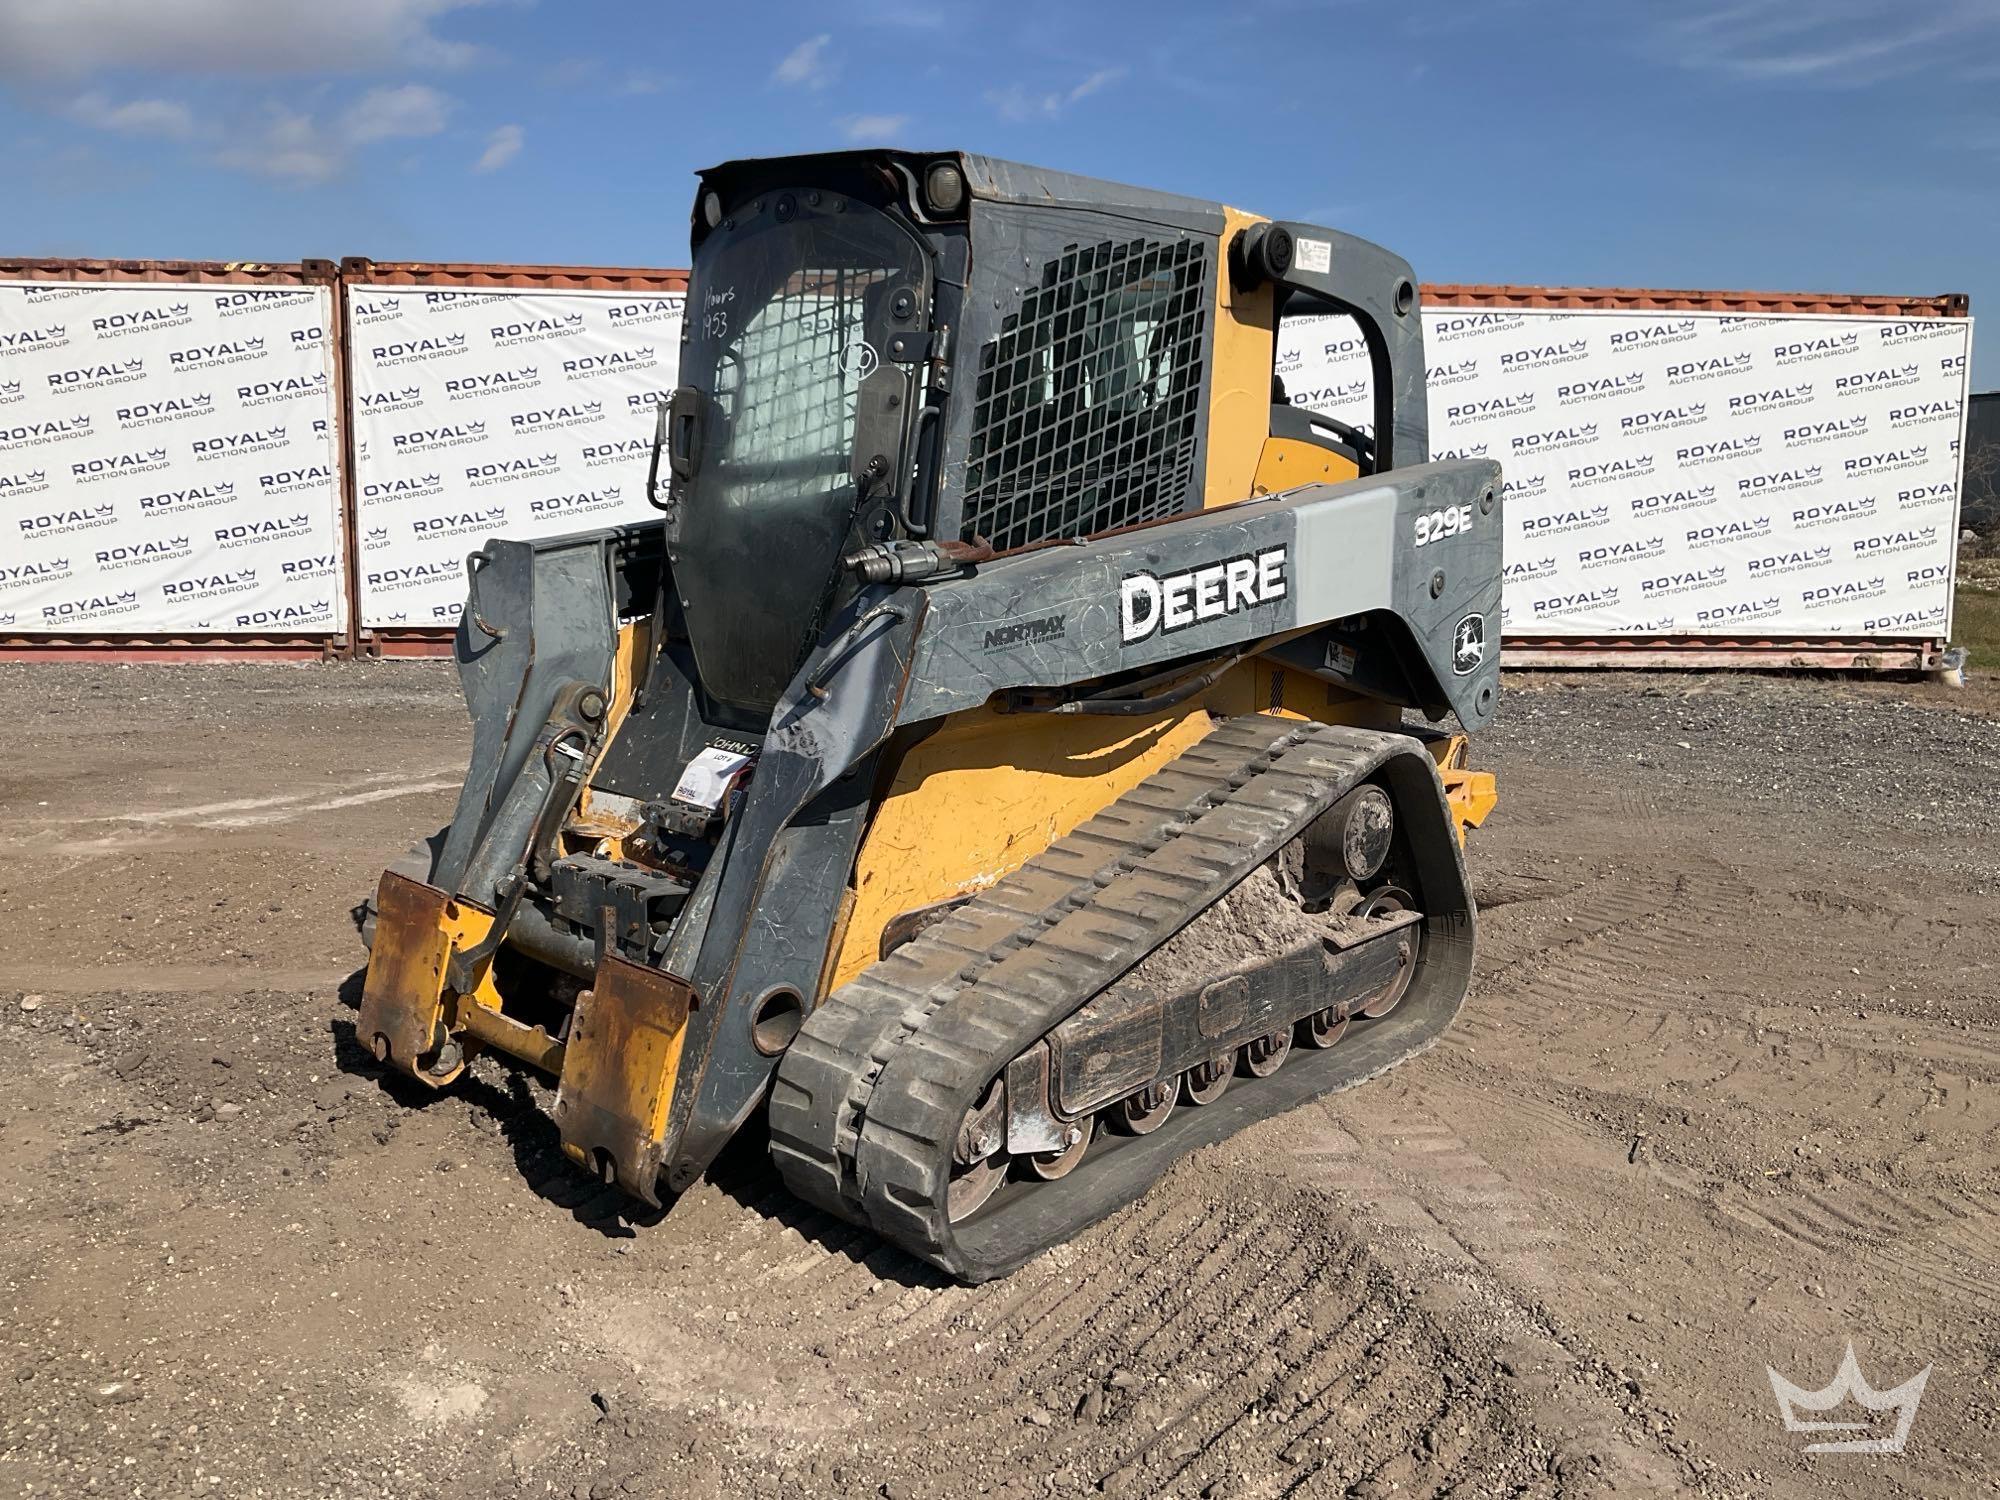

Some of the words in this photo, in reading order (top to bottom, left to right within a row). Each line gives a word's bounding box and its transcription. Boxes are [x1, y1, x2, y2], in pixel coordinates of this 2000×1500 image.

[93, 308, 170, 331] ROYAL
[97, 325, 149, 340] AUCTION
[151, 317, 192, 330] GROUP
[490, 318, 565, 339] ROYAL
[1436, 313, 1504, 334] ROYAL
[495, 334, 545, 347] AUCTION
[546, 327, 586, 339] GROUP
[1438, 328, 1485, 342] AUCTION
[1487, 321, 1524, 333] GROUP
[1610, 324, 1678, 345] ROYAL
[169, 342, 246, 364] ROYAL
[372, 338, 447, 359] ROYAL
[1612, 340, 1659, 353] AUCTION
[1661, 332, 1698, 344] GROUP
[1774, 338, 1841, 358] ROYAL
[173, 359, 225, 373] AUCTION
[227, 351, 267, 364] GROUP
[376, 354, 427, 368] AUCTION
[429, 347, 469, 359] GROUP
[563, 351, 636, 372] ROYAL
[1500, 344, 1569, 365] ROYAL
[1503, 360, 1551, 373] AUCTION
[1552, 352, 1589, 364] GROUP
[1777, 353, 1823, 366] AUCTION
[1824, 346, 1860, 357] GROUP
[47, 364, 125, 386] ROYAL
[567, 368, 617, 381] AUCTION
[618, 360, 657, 372] GROUP
[1666, 357, 1734, 377] ROYAL
[1669, 372, 1716, 385] AUCTION
[1717, 365, 1753, 377] GROUP
[53, 381, 105, 395] AUCTION
[106, 372, 148, 385] GROUP
[238, 377, 312, 399] ROYAL
[445, 371, 519, 393] ROYAL
[1557, 377, 1626, 398] ROYAL
[1835, 369, 1902, 389] ROYAL
[1838, 384, 1883, 397] AUCTION
[1885, 377, 1921, 388] GROUP
[242, 393, 292, 408] AUCTION
[449, 388, 499, 401] AUCTION
[501, 380, 540, 392] GROUP
[1560, 392, 1607, 406] AUCTION
[1609, 385, 1646, 397] GROUP
[1729, 388, 1796, 408] ROYAL
[116, 398, 193, 421] ROYAL
[510, 405, 584, 427] ROYAL
[1447, 397, 1517, 418] ROYAL
[1450, 413, 1498, 426] AUCTION
[1499, 405, 1536, 417] GROUP
[1731, 403, 1777, 416] AUCTION
[1779, 396, 1815, 408] GROUP
[121, 415, 173, 429] AUCTION
[175, 407, 216, 420] GROUP
[515, 422, 565, 435] AUCTION
[566, 414, 605, 426] GROUP
[1621, 408, 1689, 429] ROYAL
[1623, 423, 1670, 436] AUCTION
[1671, 416, 1708, 428] GROUP
[393, 426, 467, 447] ROYAL
[1511, 428, 1580, 449] ROYAL
[1783, 420, 1850, 440] ROYAL
[1786, 435, 1832, 448] AUCTION
[1833, 428, 1869, 440] GROUP
[192, 431, 268, 453] ROYAL
[197, 448, 249, 462] AUCTION
[250, 440, 290, 452] GROUP
[397, 442, 448, 455] AUCTION
[449, 434, 489, 446] GROUP
[1514, 443, 1561, 457] AUCTION
[1563, 436, 1600, 448] GROUP
[1676, 439, 1744, 460] ROYAL
[71, 453, 148, 476] ROYAL
[465, 458, 540, 479] ROYAL
[1679, 455, 1725, 468] AUCTION
[1726, 448, 1763, 459] GROUP
[1844, 450, 1910, 471] ROYAL
[1847, 465, 1892, 478] AUCTION
[1893, 458, 1929, 470] GROUP
[77, 470, 129, 484] AUCTION
[130, 461, 171, 474] GROUP
[470, 474, 520, 487] AUCTION
[522, 467, 561, 479] GROUP
[1568, 460, 1636, 481] ROYAL
[1571, 475, 1617, 488] AUCTION
[1619, 467, 1655, 479] GROUP
[1738, 470, 1805, 490] ROYAL
[139, 487, 216, 509] ROYAL
[1740, 485, 1786, 498] AUCTION
[1787, 478, 1823, 490] GROUP
[145, 503, 196, 517] AUCTION
[198, 495, 238, 508] GROUP
[530, 491, 603, 513] ROYAL
[534, 507, 584, 521] AUCTION
[585, 500, 624, 512] GROUP
[1631, 490, 1698, 511] ROYAL
[1634, 505, 1680, 518] AUCTION
[1681, 498, 1717, 510] GROUP
[19, 509, 95, 531] ROYAL
[413, 512, 486, 532] ROYAL
[1522, 510, 1591, 531] ROYAL
[1792, 501, 1859, 522] ROYAL
[1795, 516, 1840, 529] AUCTION
[1842, 509, 1877, 521] GROUP
[23, 526, 75, 540] AUCTION
[76, 518, 117, 530] GROUP
[215, 519, 290, 541] ROYAL
[417, 528, 466, 541] AUCTION
[469, 520, 508, 532] GROUP
[1414, 504, 1473, 547] 329E
[1525, 526, 1572, 539] AUCTION
[1574, 518, 1611, 530] GROUP
[1686, 521, 1753, 542] ROYAL
[218, 536, 269, 550] AUCTION
[271, 528, 311, 540] GROUP
[1689, 536, 1734, 549] AUCTION
[1736, 529, 1772, 541] GROUP
[1853, 531, 1919, 551] ROYAL
[1856, 546, 1901, 559] AUCTION
[1902, 539, 1938, 550] GROUP
[95, 541, 171, 563] ROYAL
[100, 557, 151, 571] AUCTION
[153, 549, 193, 562] GROUP
[1579, 541, 1647, 562] ROYAL
[1748, 551, 1814, 571] ROYAL
[162, 574, 238, 596] ROYAL
[367, 564, 442, 585] ROYAL
[372, 580, 422, 593] AUCTION
[423, 572, 463, 584] GROUP
[1641, 571, 1708, 592] ROYAL
[167, 590, 218, 604] AUCTION
[220, 582, 260, 594] GROUP
[1121, 547, 1286, 642] DEERE
[1533, 591, 1601, 612] ROYAL
[1802, 581, 1868, 602] ROYAL
[41, 596, 118, 618] ROYAL
[47, 612, 98, 626] AUCTION
[100, 604, 140, 616] GROUP
[1536, 607, 1583, 620] AUCTION
[1584, 599, 1621, 611] GROUP
[1697, 602, 1763, 622] ROYAL
[1746, 609, 1782, 621] GROUP
